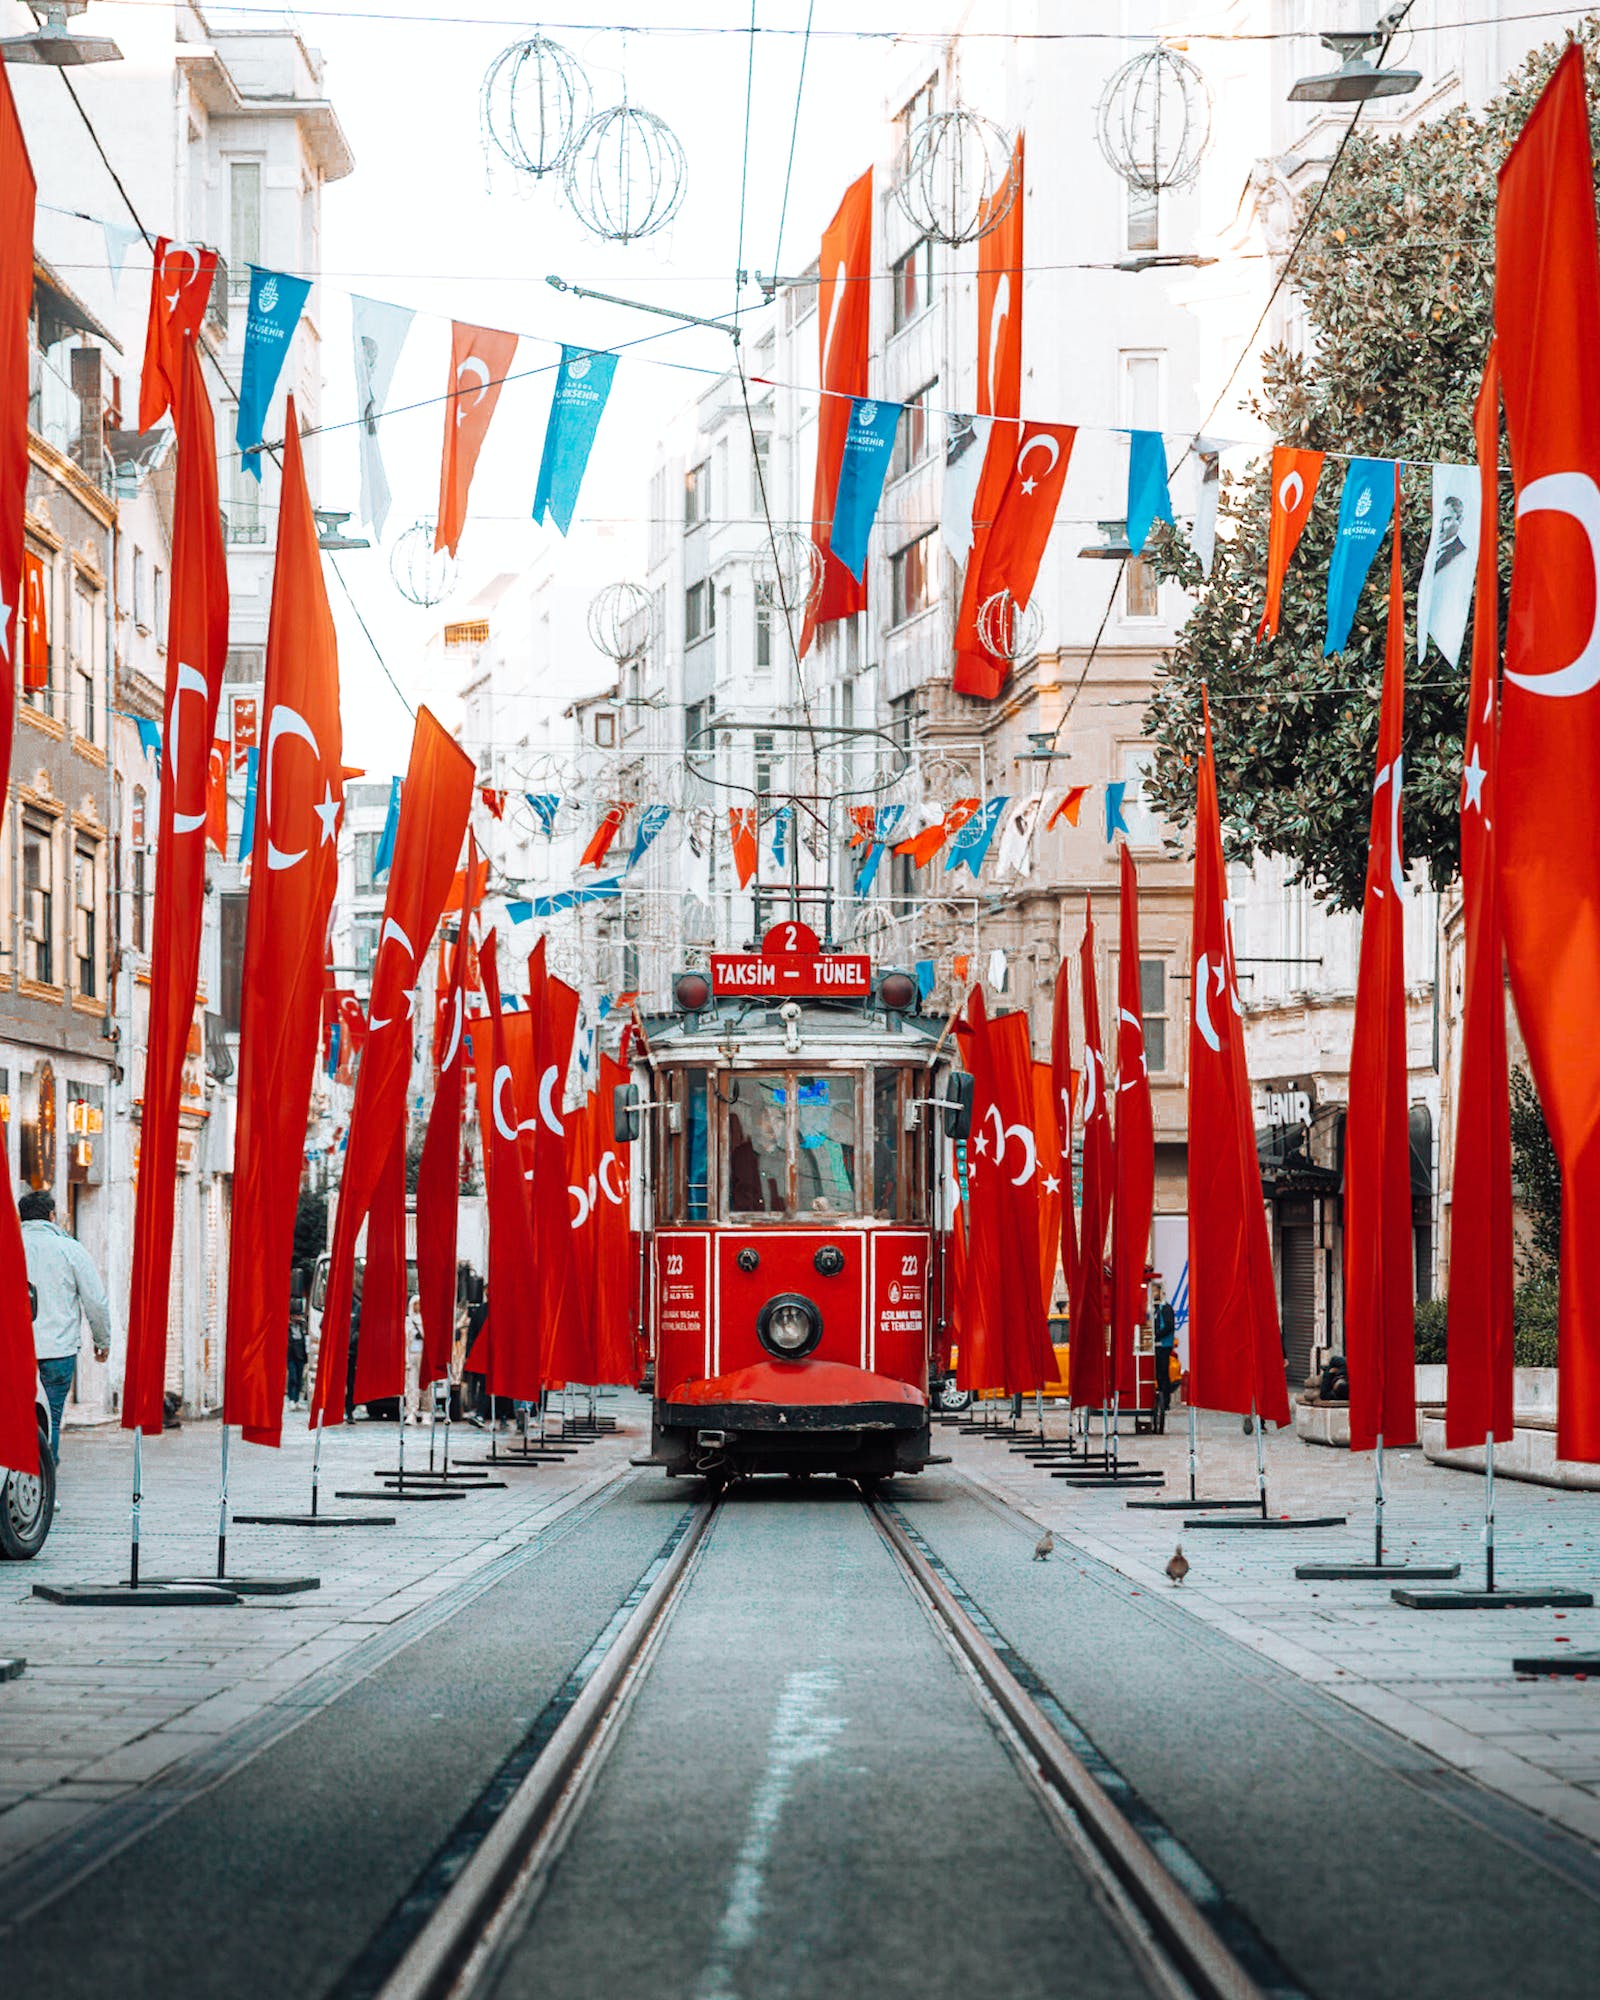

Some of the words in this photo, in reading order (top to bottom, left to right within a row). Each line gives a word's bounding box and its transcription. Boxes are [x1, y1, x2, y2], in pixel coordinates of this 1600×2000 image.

[785, 925, 797, 951] 2
[716, 959, 775, 985] TAKSİM
[813, 958, 865, 985] TÜNEL
[667, 1255, 683, 1275] 223
[901, 1255, 918, 1276] 223
[880, 1321, 890, 1332] VE
